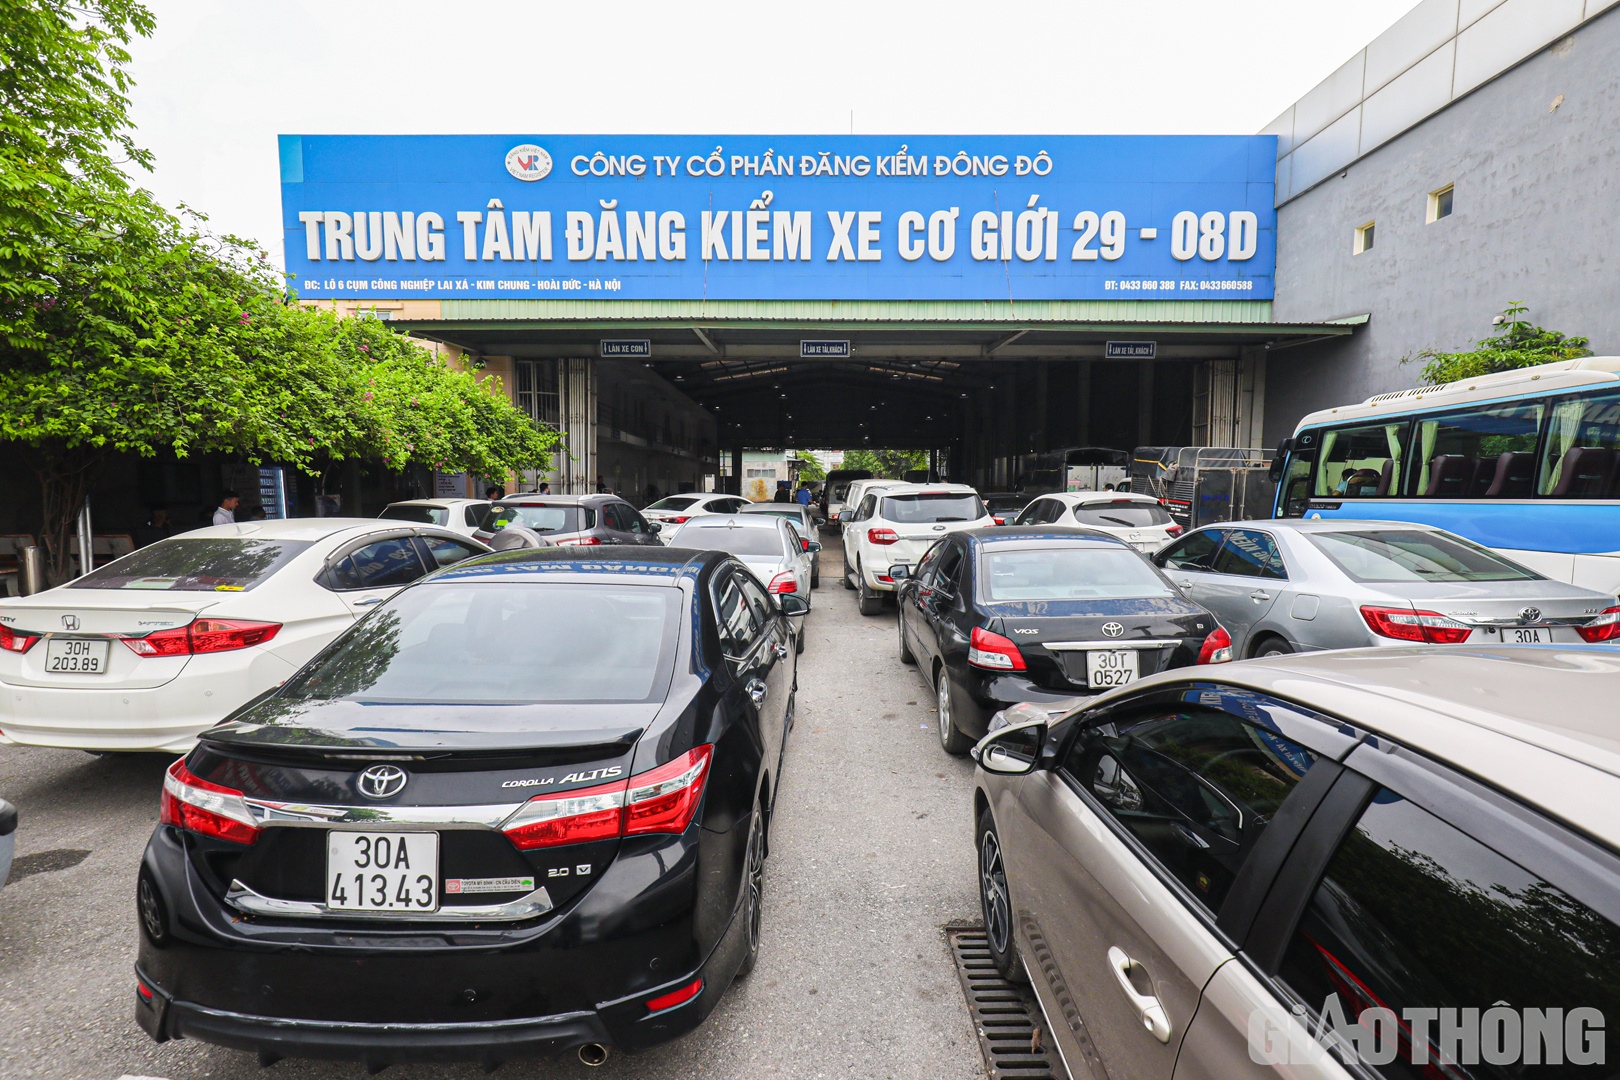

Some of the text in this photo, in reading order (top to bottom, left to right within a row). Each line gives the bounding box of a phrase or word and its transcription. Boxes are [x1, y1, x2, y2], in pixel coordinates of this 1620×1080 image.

[570, 144, 1053, 177] CÔNG TY CỔ PHẦN ĐĂNG KIỂM ĐÔNG ĐÔ
[299, 211, 446, 261] TRUNG
[456, 198, 553, 261] TÂM
[565, 199, 686, 261] ĐĂNG
[701, 190, 812, 262] KIỂM
[826, 211, 882, 261] XE
[898, 206, 960, 261] CƠ
[970, 194, 1058, 261] GIỚI
[1071, 211, 1126, 261] 29
[1170, 211, 1258, 261] 08D
[304, 280, 321, 290] ĐC:
[324, 278, 336, 290] LÔ
[338, 280, 345, 290] 6
[346, 280, 368, 292] CỤM
[371, 278, 398, 290] CÔNG
[400, 278, 435, 292] NGHIỆP
[437, 280, 453, 290] LAI
[455, 278, 469, 290] XÁ
[476, 280, 495, 290] KIM
[497, 280, 530, 290] CHUNG
[537, 278, 560, 290] HOÀI
[562, 278, 582, 290] ĐỨC
[588, 278, 602, 290] HÀ
[604, 278, 621, 292] NỘI
[1104, 280, 1118, 290] ĐT:
[1119, 280, 1141, 290] 0433
[1141, 280, 1158, 290] 660
[1159, 280, 1175, 290] 388
[1179, 280, 1199, 290] FAX:
[608, 343, 644, 353] LÀN XE CON
[1514, 629, 1541, 643] 30A
[65, 641, 90, 656] 30H
[52, 656, 99, 671] 203.89
[1097, 652, 1127, 669] 30T
[1093, 669, 1133, 686] 0527
[501, 765, 623, 788] COROLLA ALTIS
[354, 835, 411, 870] 30A
[547, 867, 570, 878] 2.0
[331, 872, 434, 908] 413.43
